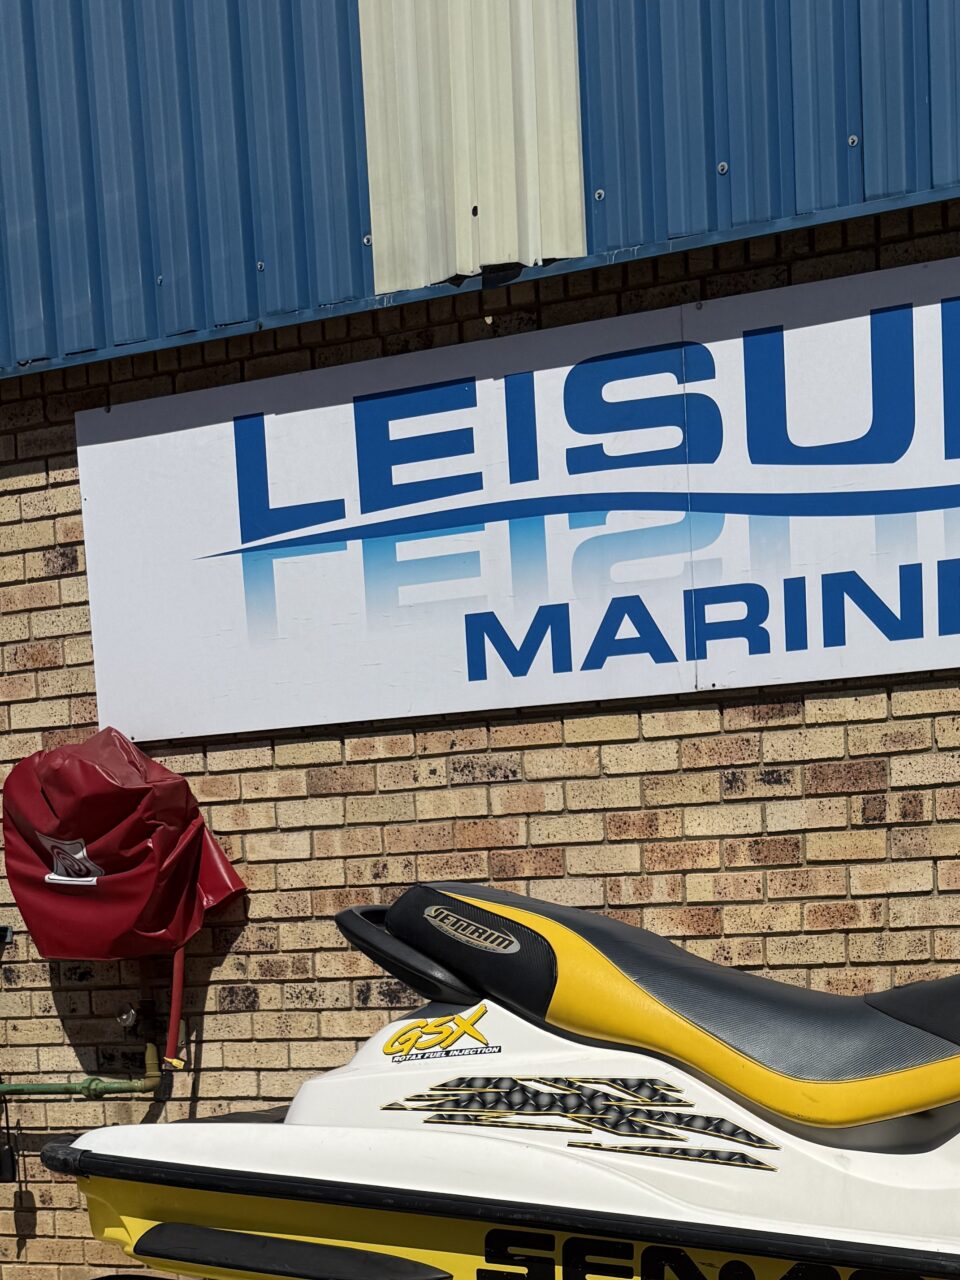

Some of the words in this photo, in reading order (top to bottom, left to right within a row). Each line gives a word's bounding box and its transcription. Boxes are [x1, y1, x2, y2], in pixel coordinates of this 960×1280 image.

[426, 907, 515, 950] JETTRIM
[384, 1004, 489, 1055] GSX
[393, 1053, 422, 1063] ROTAX
[423, 1051, 447, 1059] FUEL
[449, 1046, 500, 1056] INJECTION
